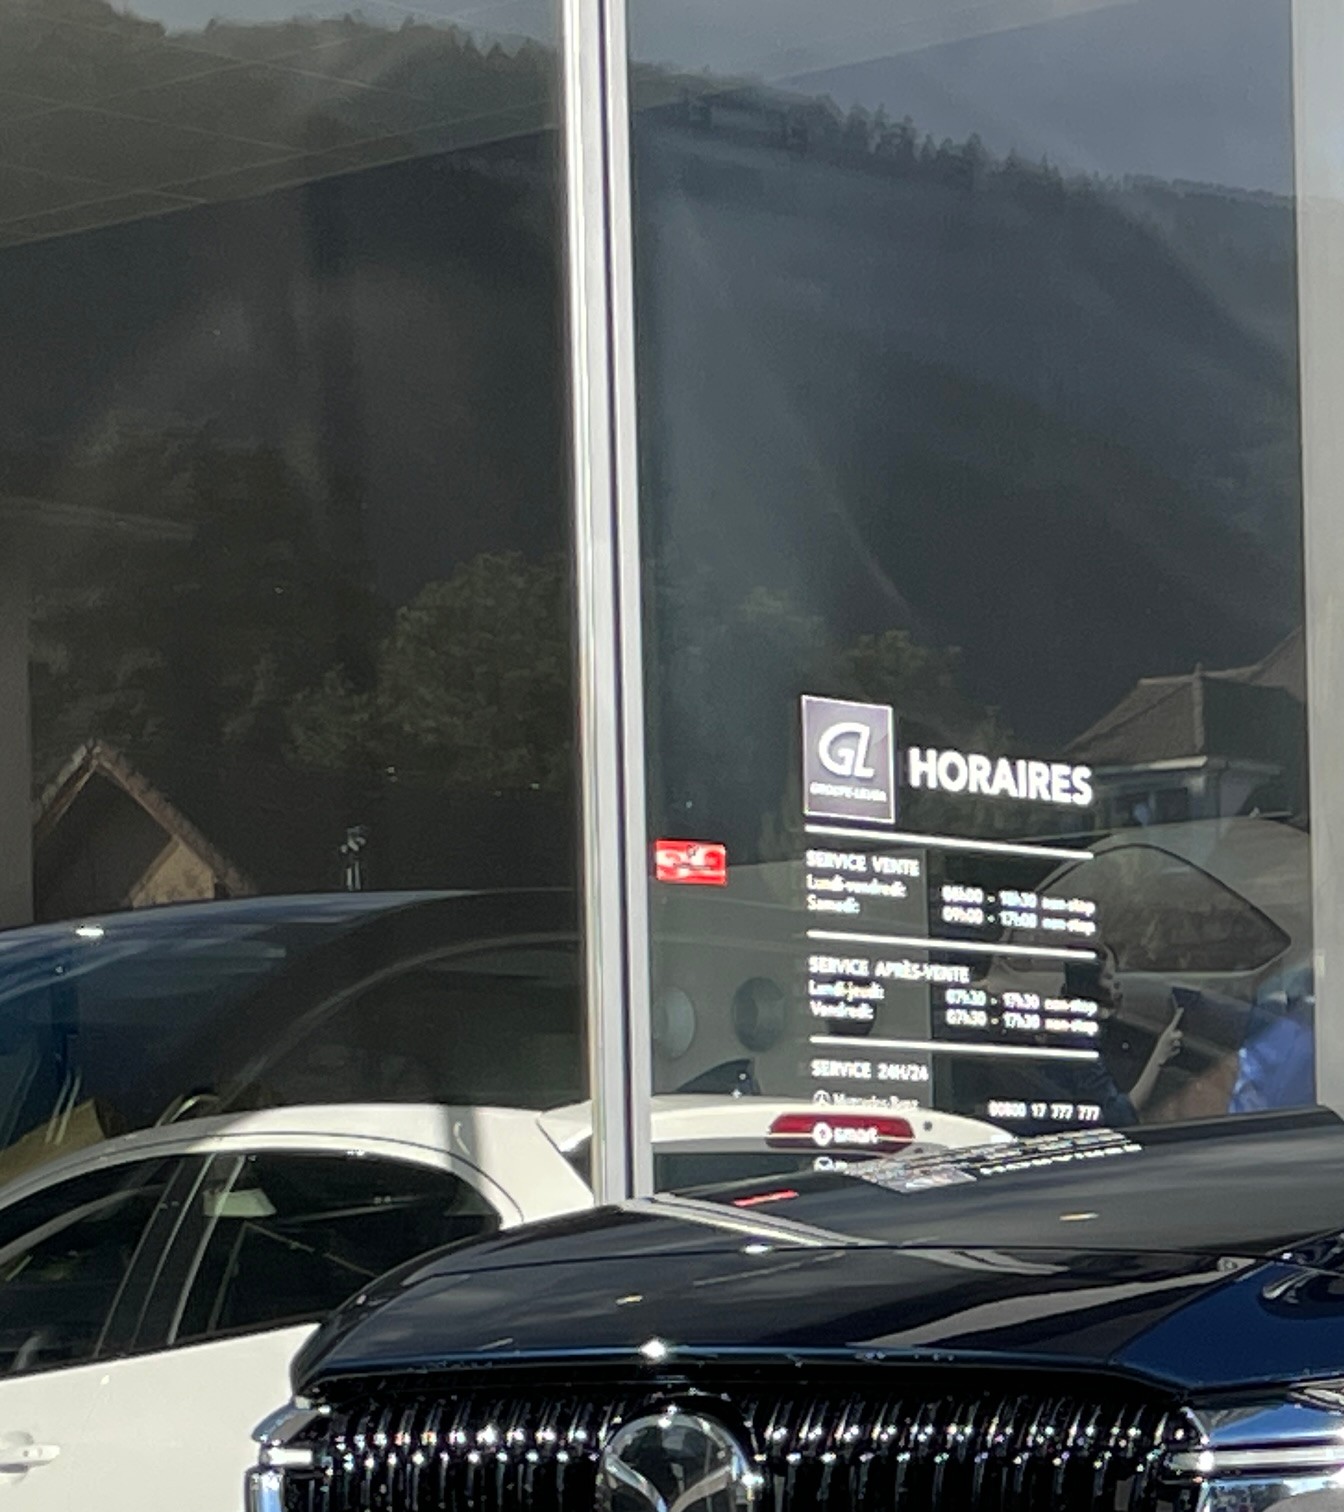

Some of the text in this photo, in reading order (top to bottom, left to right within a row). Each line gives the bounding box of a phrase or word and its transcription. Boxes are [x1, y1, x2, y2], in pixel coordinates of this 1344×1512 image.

[908, 747, 1093, 806] HORAIRES
[806, 849, 920, 877] SERVICE VENTE
[808, 955, 870, 977] SERVICE
[811, 1059, 872, 1079] SERVICE
[1031, 1101, 1048, 1118] 17
[1050, 1102, 1074, 1120] 777
[1077, 1104, 1101, 1121] 777
